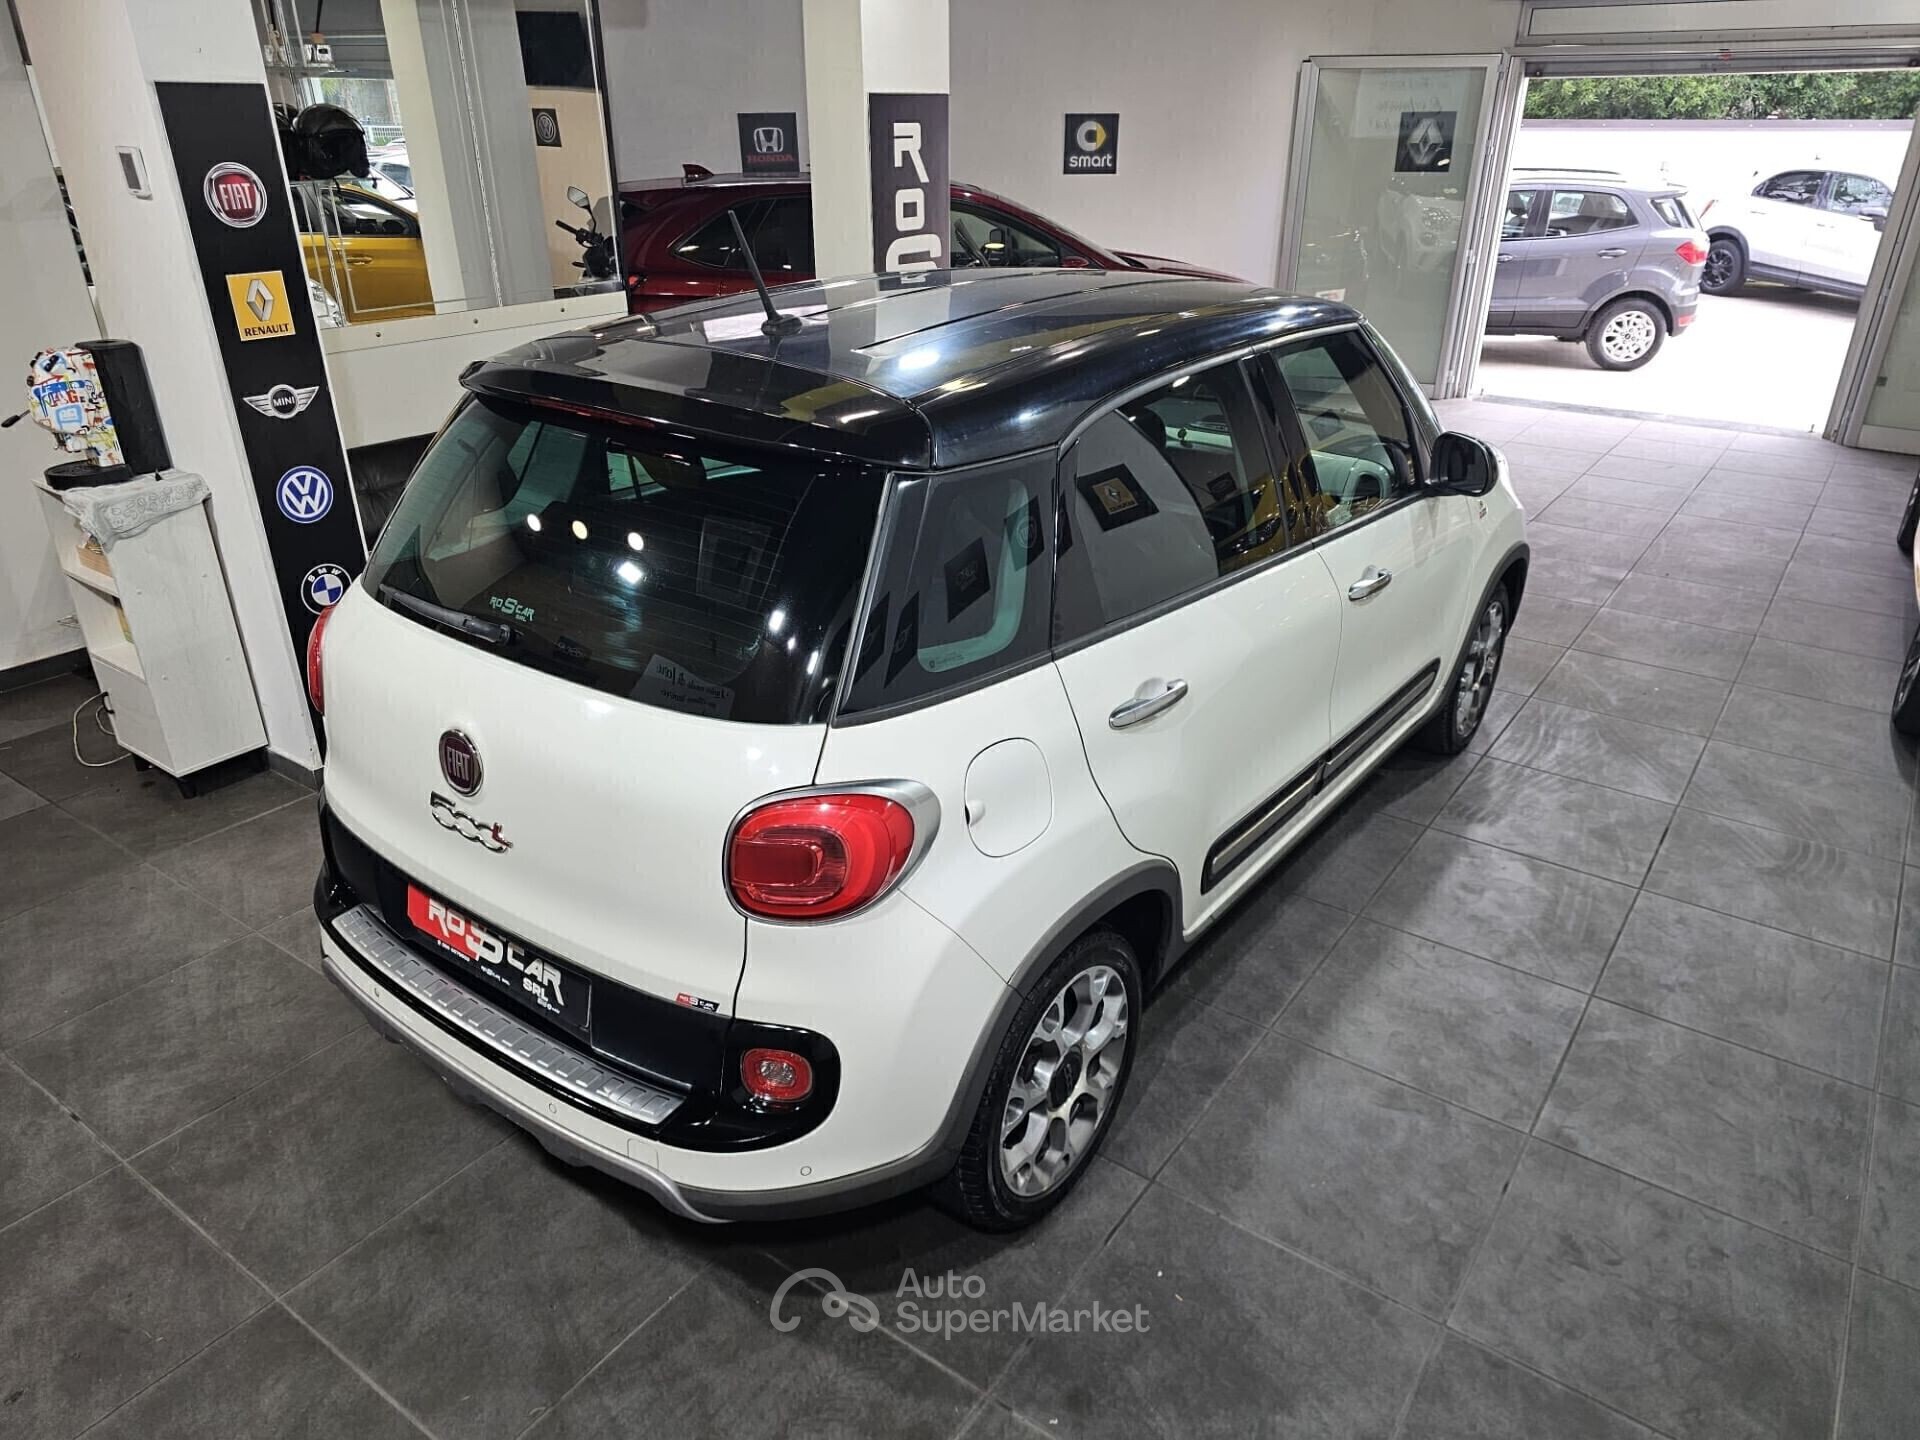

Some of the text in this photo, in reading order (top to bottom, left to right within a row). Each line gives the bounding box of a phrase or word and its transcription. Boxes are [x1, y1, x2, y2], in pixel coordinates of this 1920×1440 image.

[747, 153, 796, 164] HONDA
[1069, 153, 1113, 168] smart
[218, 182, 253, 211] FIAT
[244, 323, 290, 337] RENAULT
[272, 396, 296, 407] MINI
[307, 566, 342, 583] BMW
[489, 596, 535, 622] ROSCAR
[446, 745, 471, 782] FIAT
[430, 790, 514, 854] 500L
[428, 897, 565, 1007] ROSCAR
[522, 977, 549, 1001] SRL
